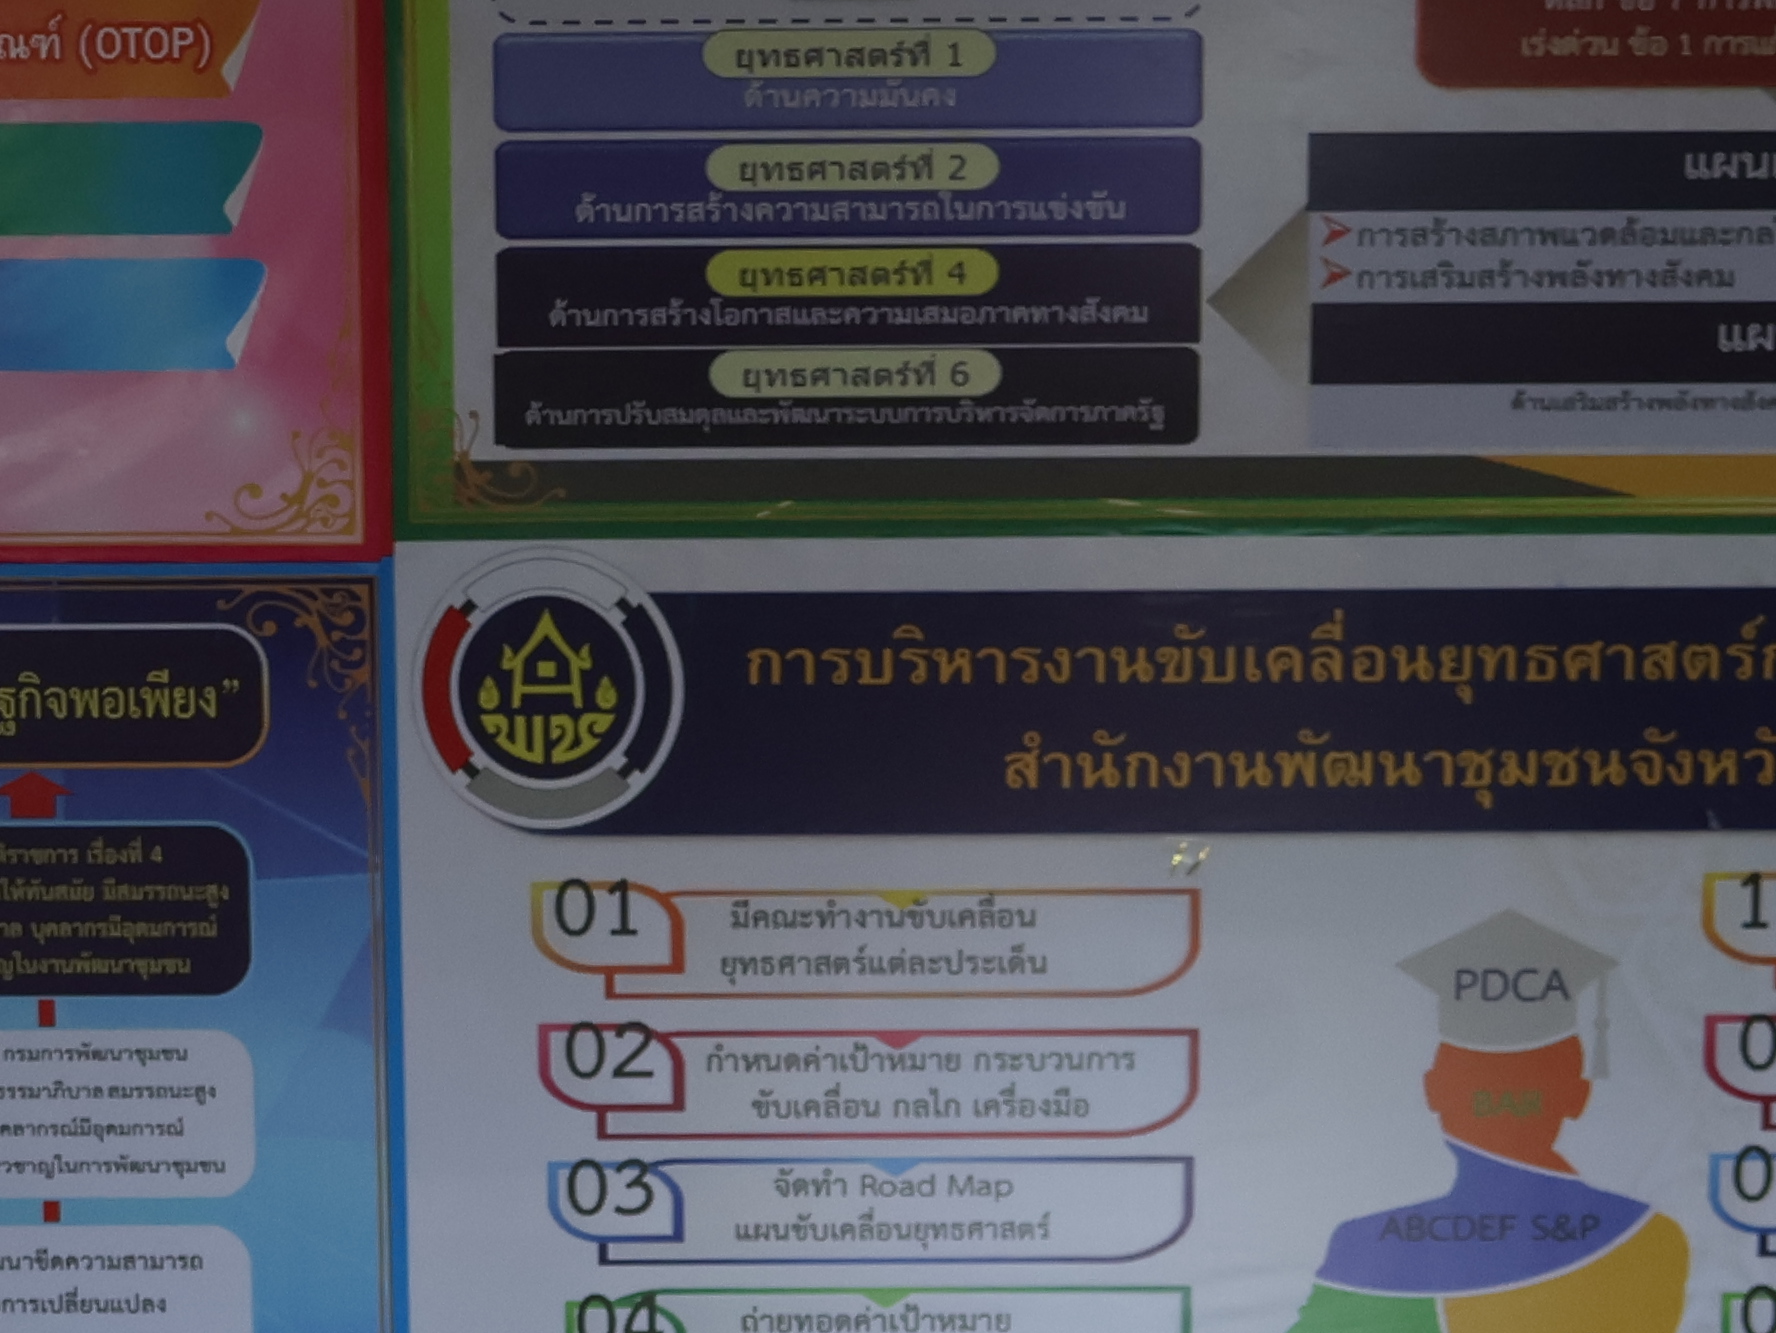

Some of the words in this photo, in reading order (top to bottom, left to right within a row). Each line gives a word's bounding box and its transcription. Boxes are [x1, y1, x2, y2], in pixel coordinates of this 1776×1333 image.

[77, 21, 212, 70] (OTOP)
[947, 42, 963, 68] 1
[947, 155, 967, 181] 2
[947, 260, 967, 286] 4
[950, 361, 970, 388] 6
[149, 846, 163, 864] 4
[554, 878, 638, 937] 01
[1454, 968, 1571, 1002] PDCA
[565, 1022, 655, 1079] 02
[566, 1158, 657, 1216] 03
[859, 1174, 936, 1197] Road
[948, 1175, 1013, 1202] Map
[1378, 1214, 1516, 1242] ABCDEF
[1530, 1214, 1601, 1242] S&P
